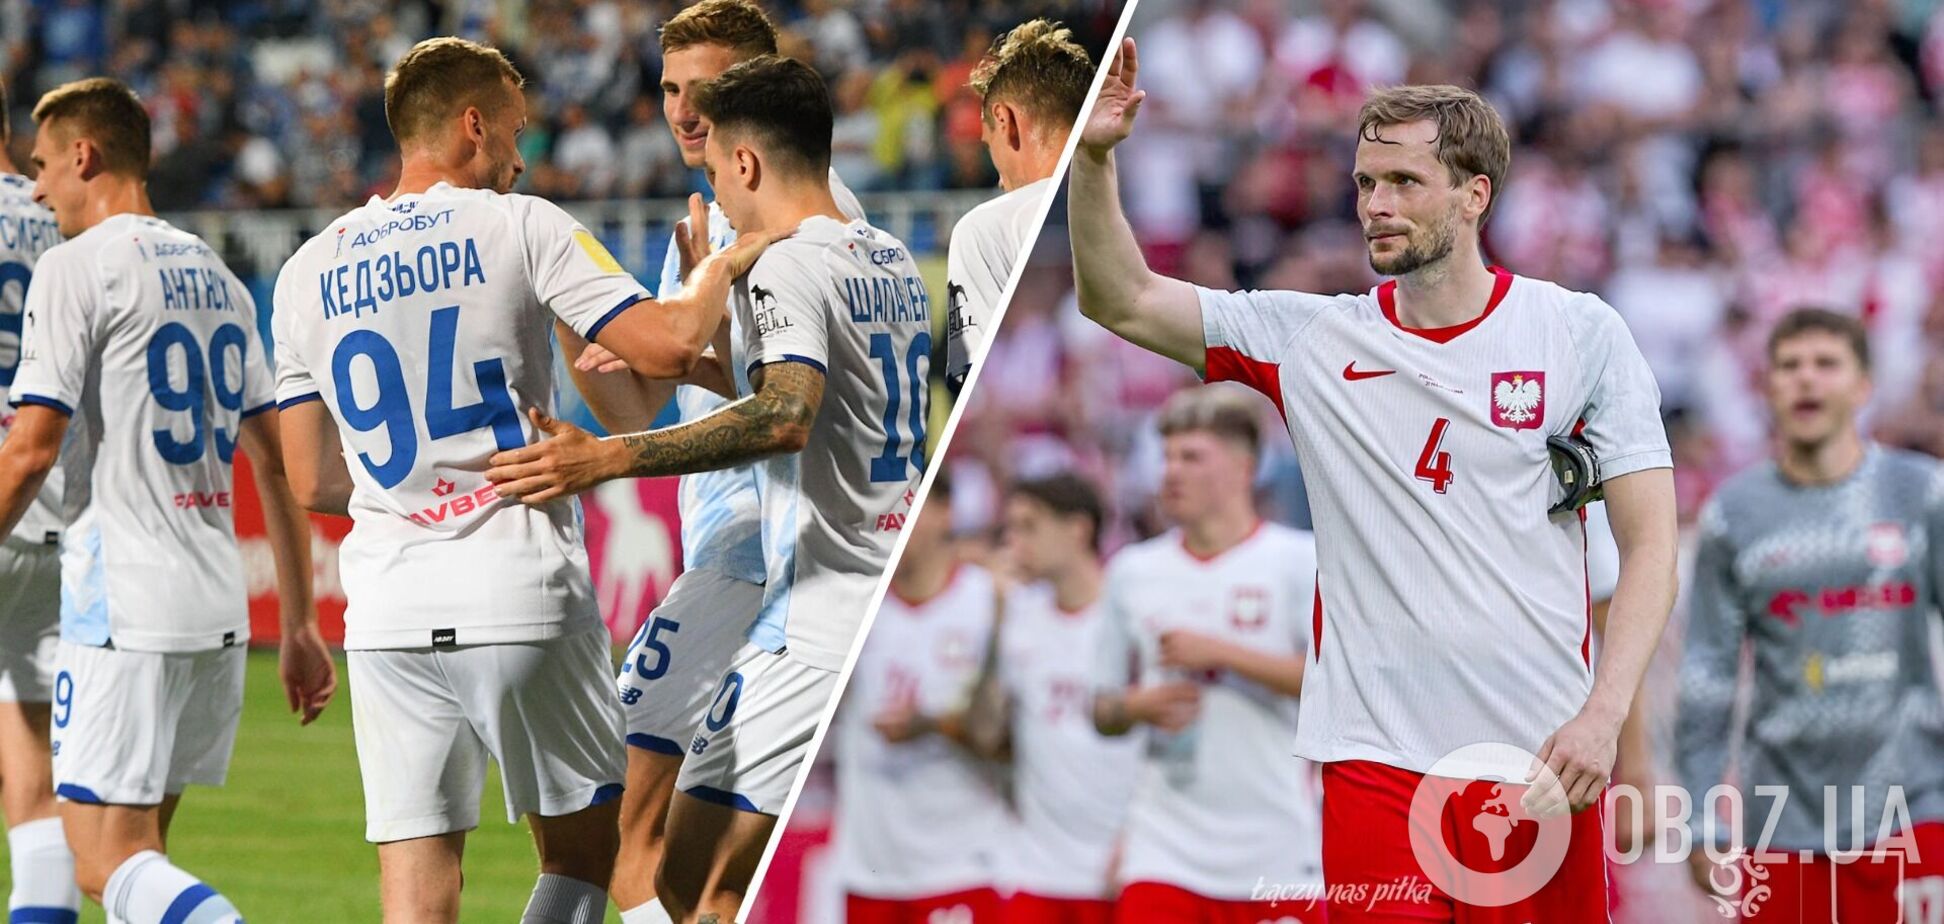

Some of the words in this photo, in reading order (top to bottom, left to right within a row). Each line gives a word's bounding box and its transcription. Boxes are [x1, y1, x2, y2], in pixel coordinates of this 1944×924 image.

[0, 214, 61, 254] СИРОТ
[352, 209, 456, 249] ДОБРОБУТ
[158, 268, 235, 311] АНТЮХ
[320, 238, 486, 320] КЕДЗЬОРА
[755, 307, 776, 324] PIT
[757, 316, 794, 337] BULL
[147, 322, 247, 465] 99
[332, 305, 526, 489] 94
[869, 332, 932, 483] 10
[1414, 417, 1454, 495] 4
[174, 492, 231, 509] FAVE
[54, 670, 74, 728] 9
